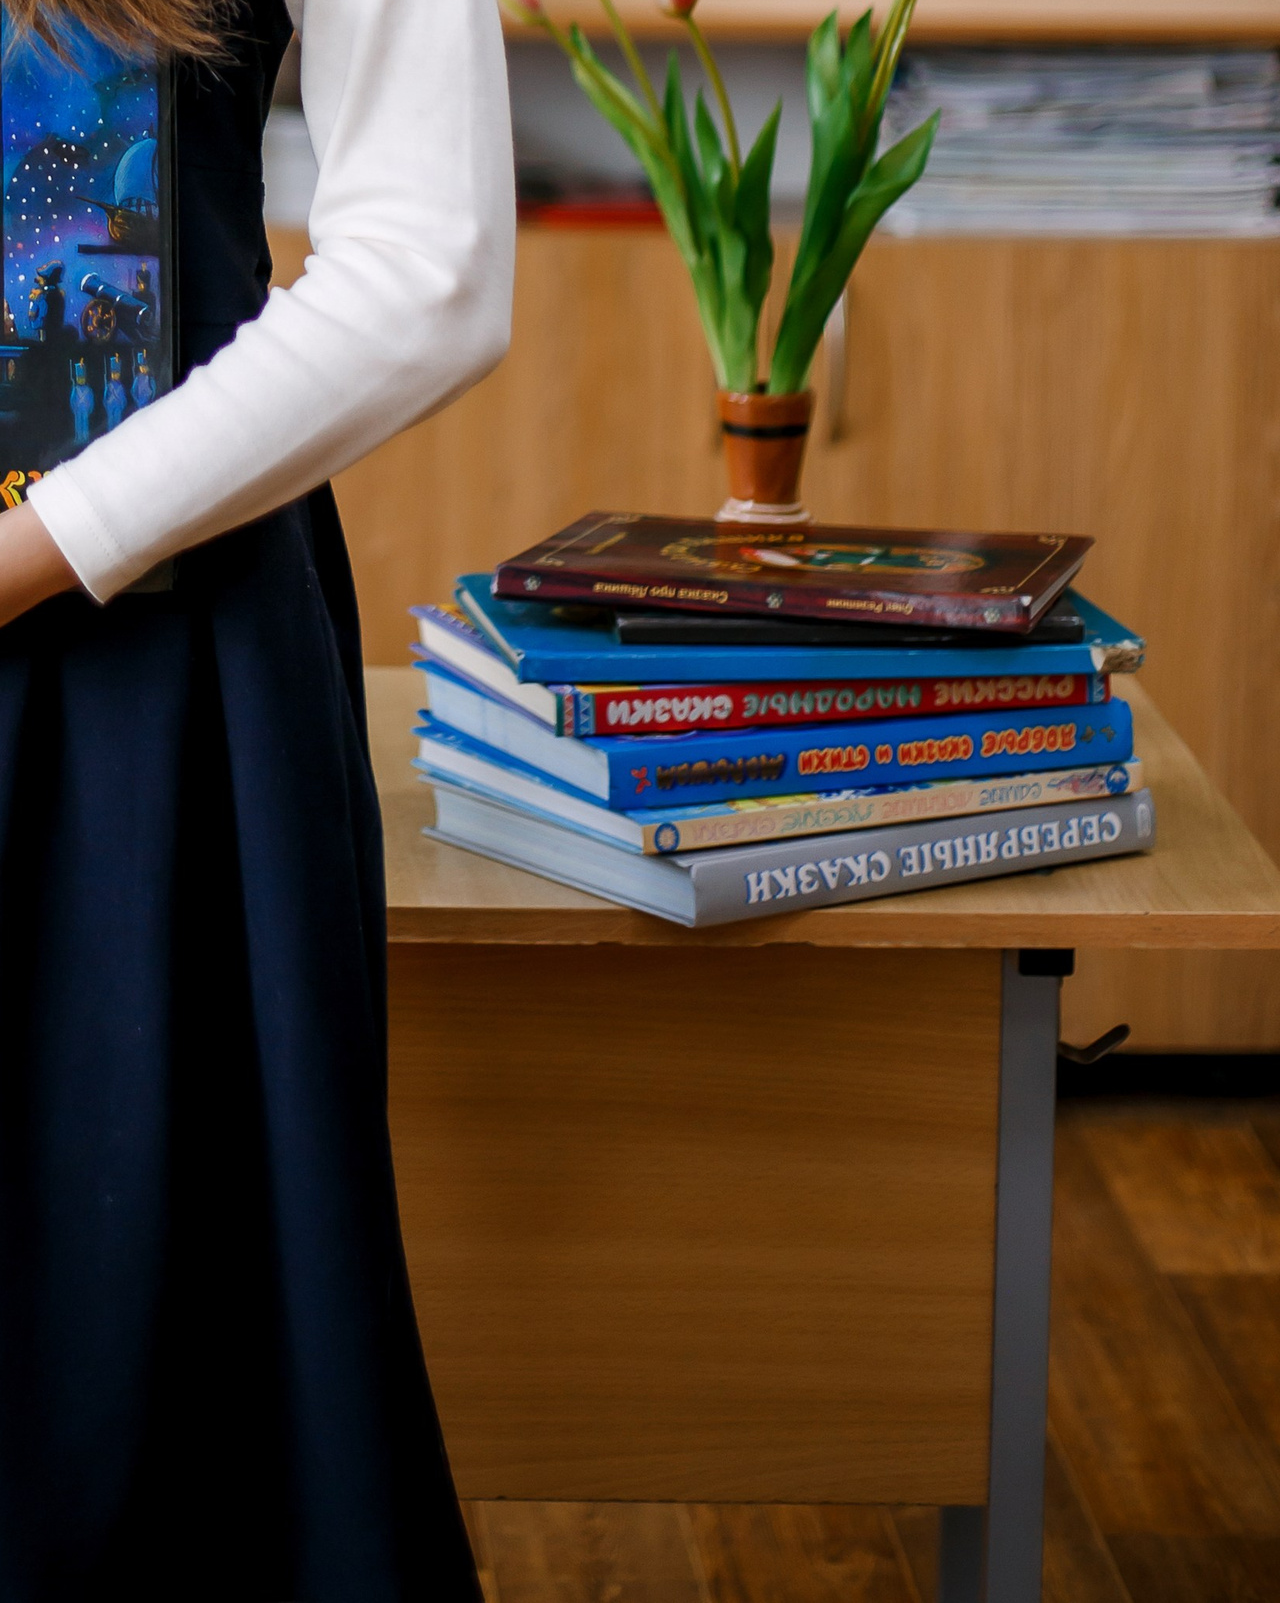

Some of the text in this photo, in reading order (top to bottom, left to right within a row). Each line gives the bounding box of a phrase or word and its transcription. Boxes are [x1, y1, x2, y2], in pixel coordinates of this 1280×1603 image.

[606, 675, 1076, 726] РУССКИЕ НАРОДНЫЕ СКАЗКИ
[897, 735, 974, 766] СКАЗКИ
[980, 723, 1077, 758] ДОБРЫЕ
[798, 744, 870, 776] СТИХИ
[745, 811, 1122, 904] СЕРЕБРЯНЫЕ СКАЗКИ
